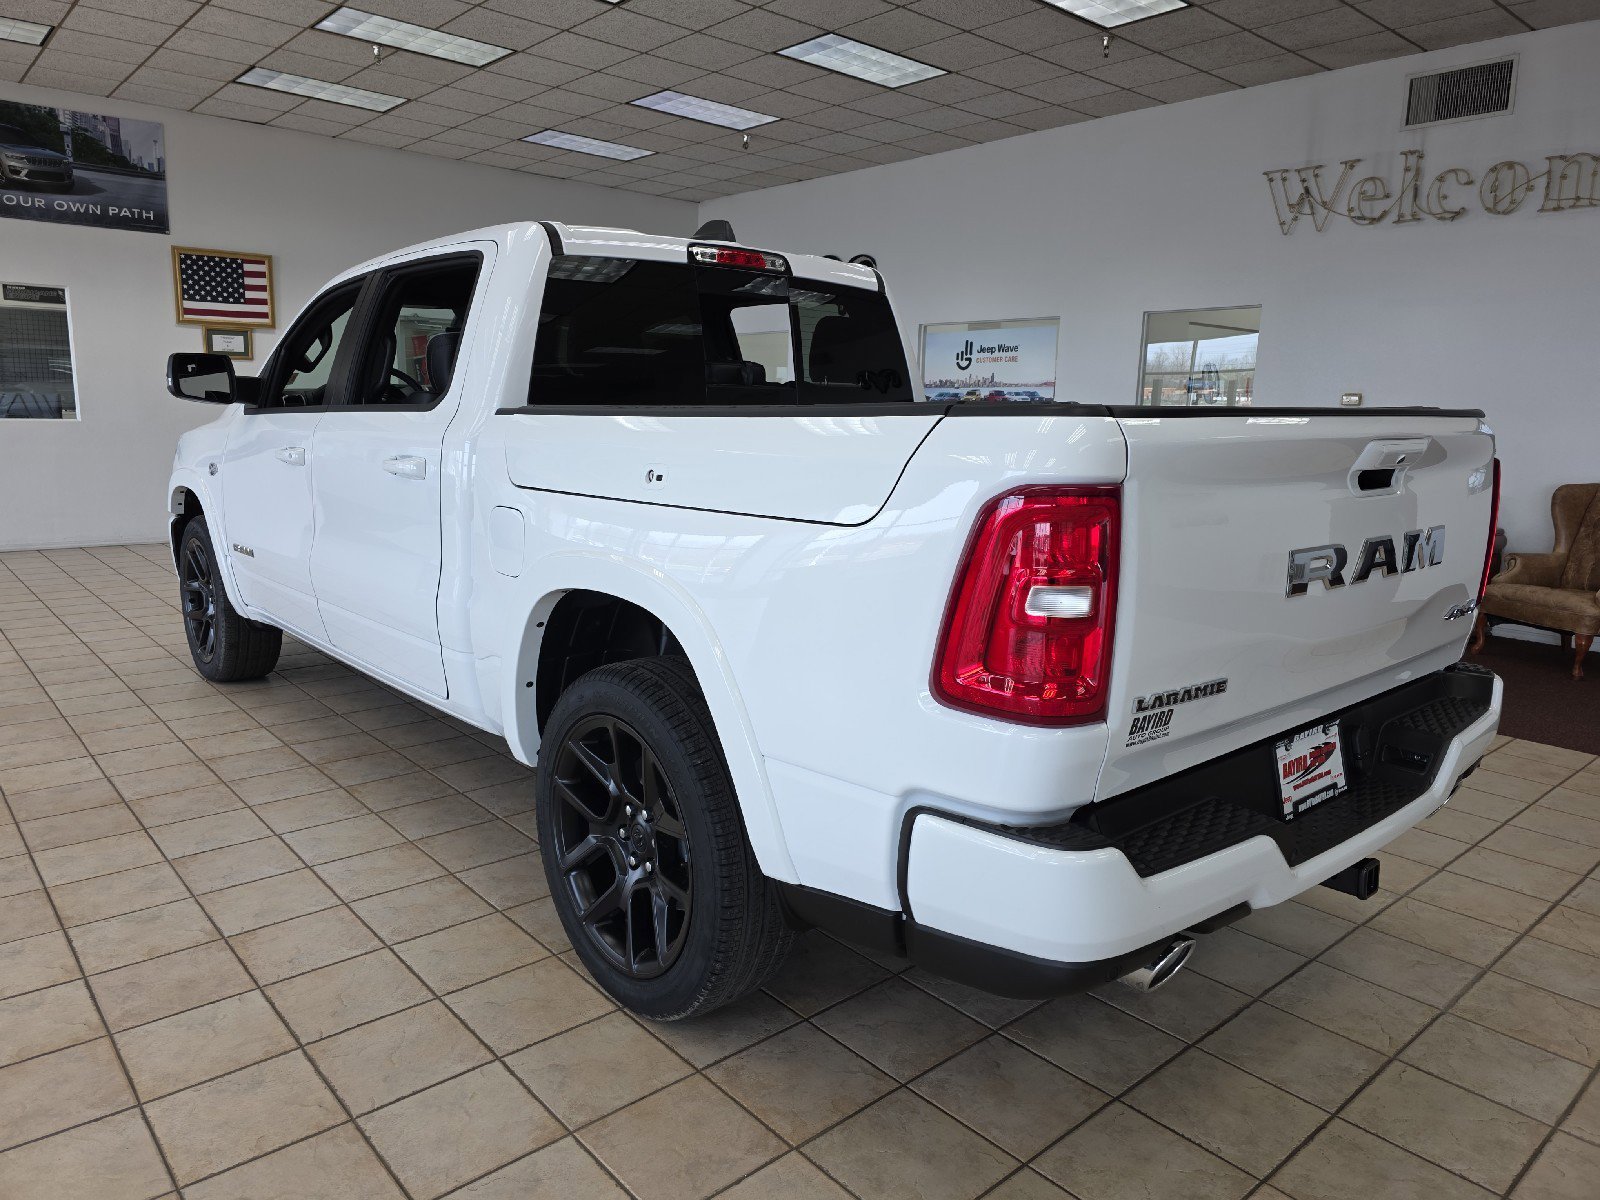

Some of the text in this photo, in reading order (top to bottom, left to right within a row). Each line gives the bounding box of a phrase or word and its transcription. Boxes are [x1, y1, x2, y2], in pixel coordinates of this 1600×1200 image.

[0, 193, 154, 221] OUR OWN PATH
[977, 343, 1019, 355] Jeep Wave
[1285, 525, 1446, 599] RAM
[1131, 677, 1228, 714] LARAMIE
[1128, 708, 1175, 737] BAYIRD
